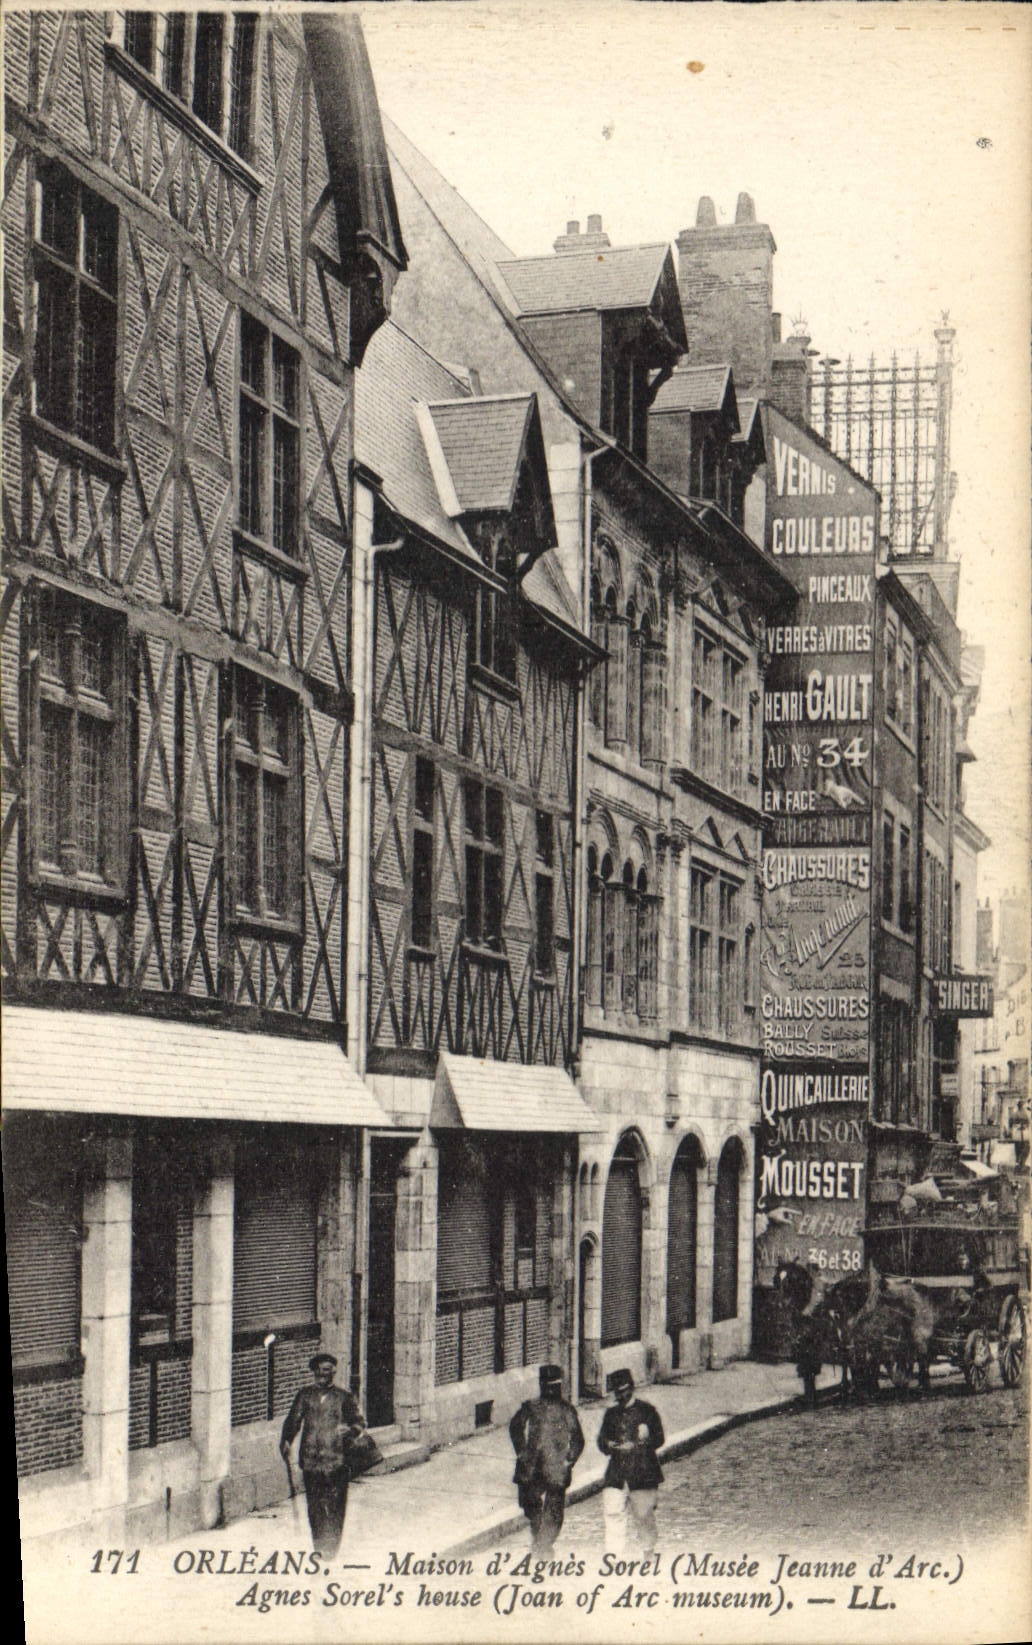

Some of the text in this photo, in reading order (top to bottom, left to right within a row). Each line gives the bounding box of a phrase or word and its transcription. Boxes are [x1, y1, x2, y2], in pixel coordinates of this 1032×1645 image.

[773, 435, 836, 496] VERNIS
[772, 515, 875, 555] COULEURS
[809, 574, 871, 602] PINCEAUX
[767, 626, 818, 653] VERRES
[825, 624, 871, 651] VITRES
[764, 669, 873, 722] HENRI GAULT
[766, 744, 786, 769] AU
[816, 737, 870, 768] 34
[764, 789, 816, 811] EN FACE
[762, 851, 870, 891] CHAUSSURES
[761, 993, 869, 1019] CHAUSSURES
[763, 1022, 814, 1040] BALLY
[763, 1040, 836, 1062] ROUSSET
[761, 1069, 869, 1126] QUINCAILLERIE
[769, 1117, 865, 1146] MAISON
[757, 1148, 865, 1208] MOUSSET
[841, 1248, 862, 1271] 38
